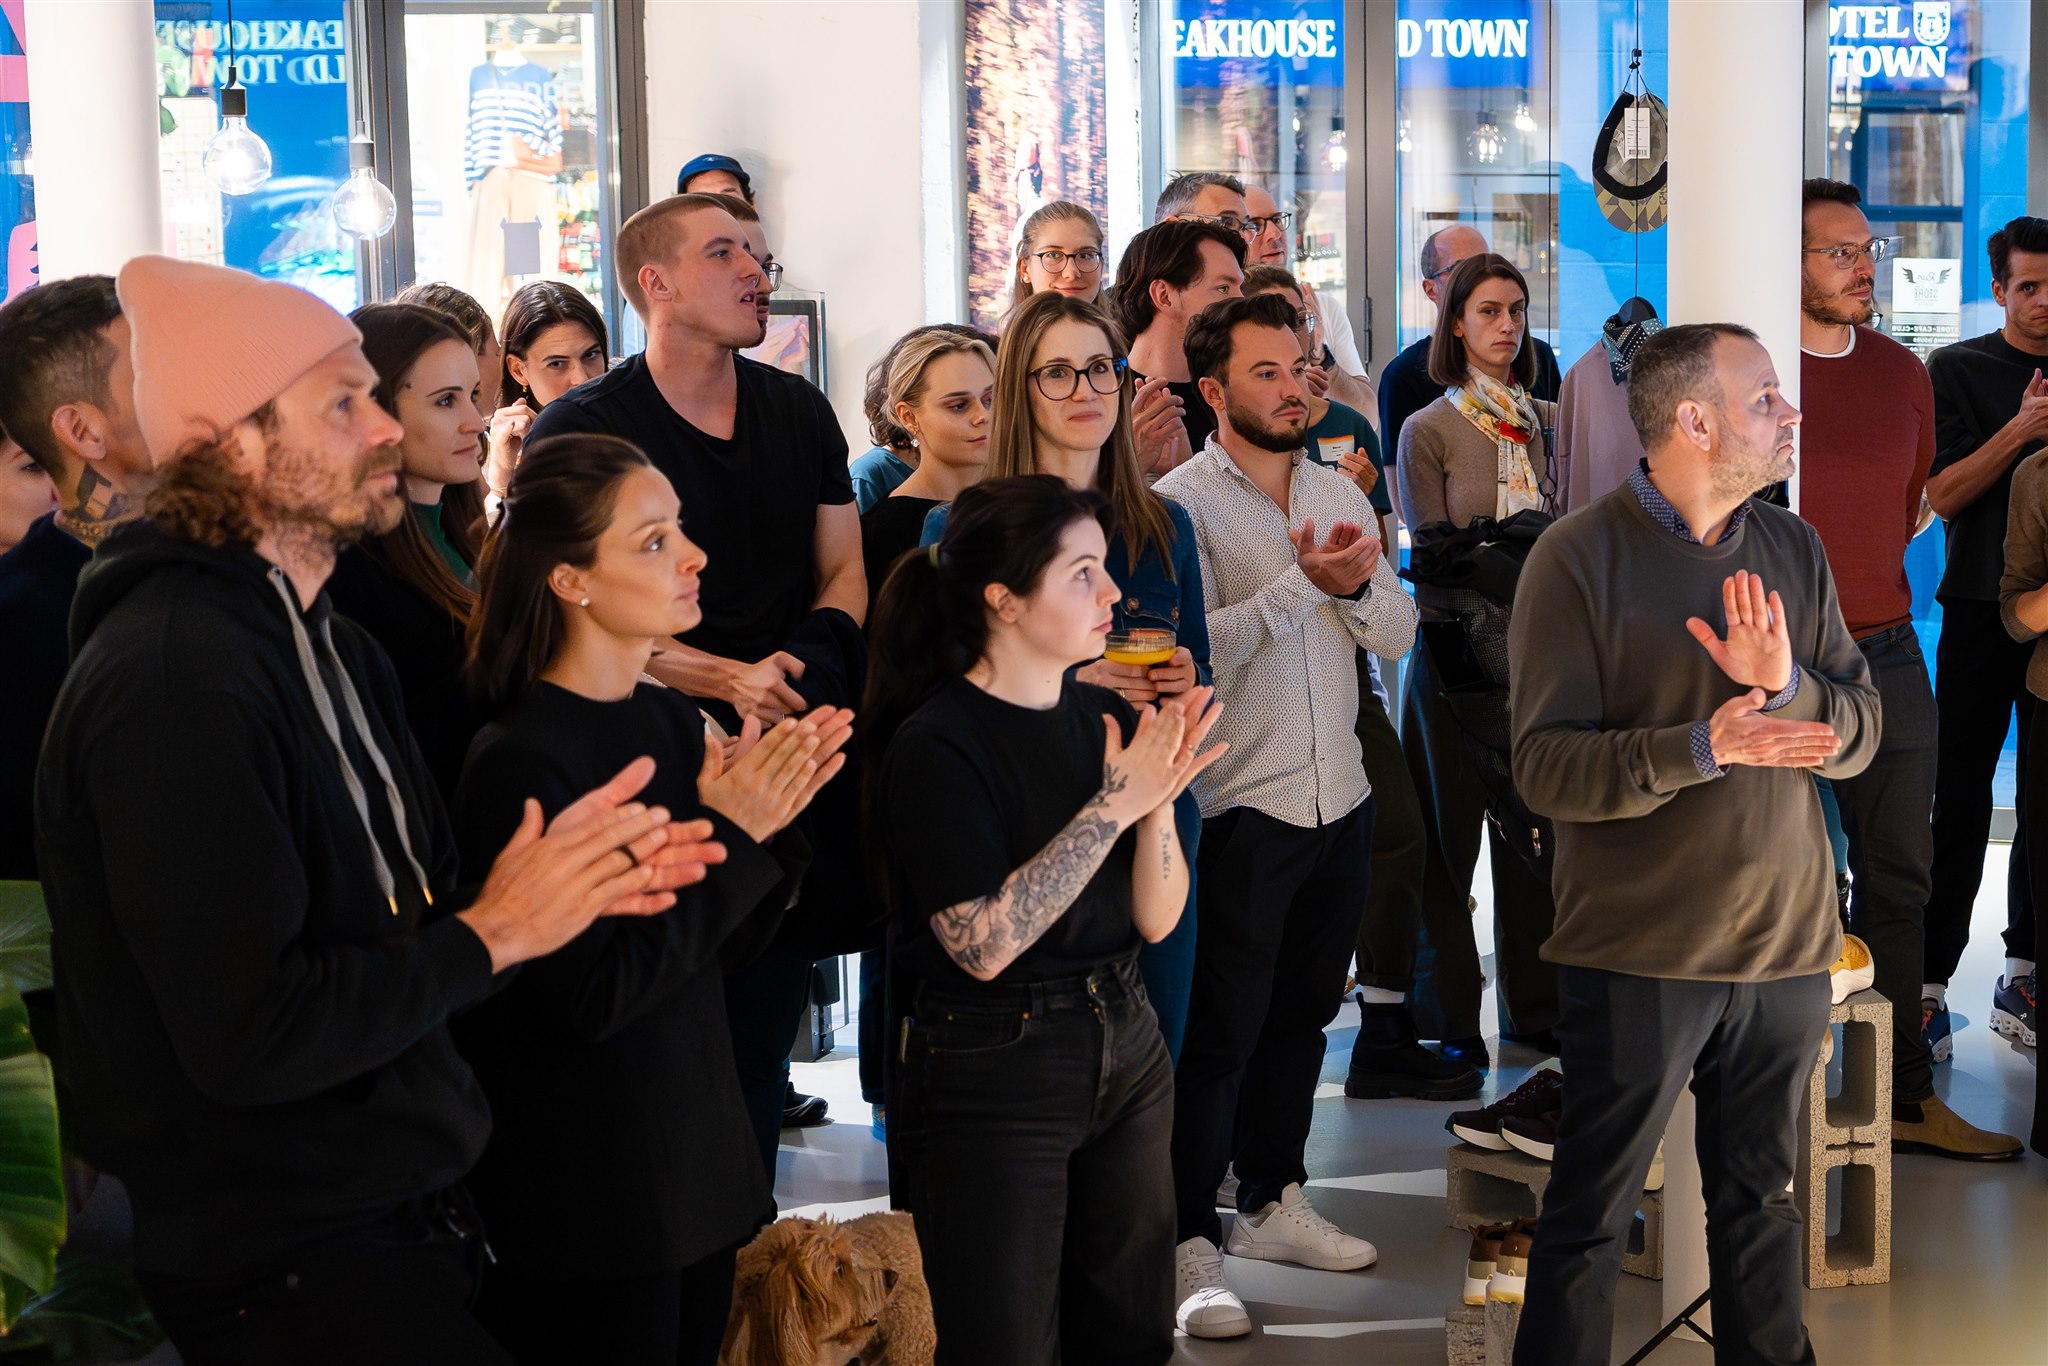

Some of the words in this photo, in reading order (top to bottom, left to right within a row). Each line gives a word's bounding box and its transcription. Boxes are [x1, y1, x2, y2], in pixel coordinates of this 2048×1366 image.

[1163, 19, 1337, 58] EAKHOUSE
[1398, 19, 1422, 57] D
[1425, 19, 1529, 58] TOWN
[1829, 45, 1948, 78] TOWN
